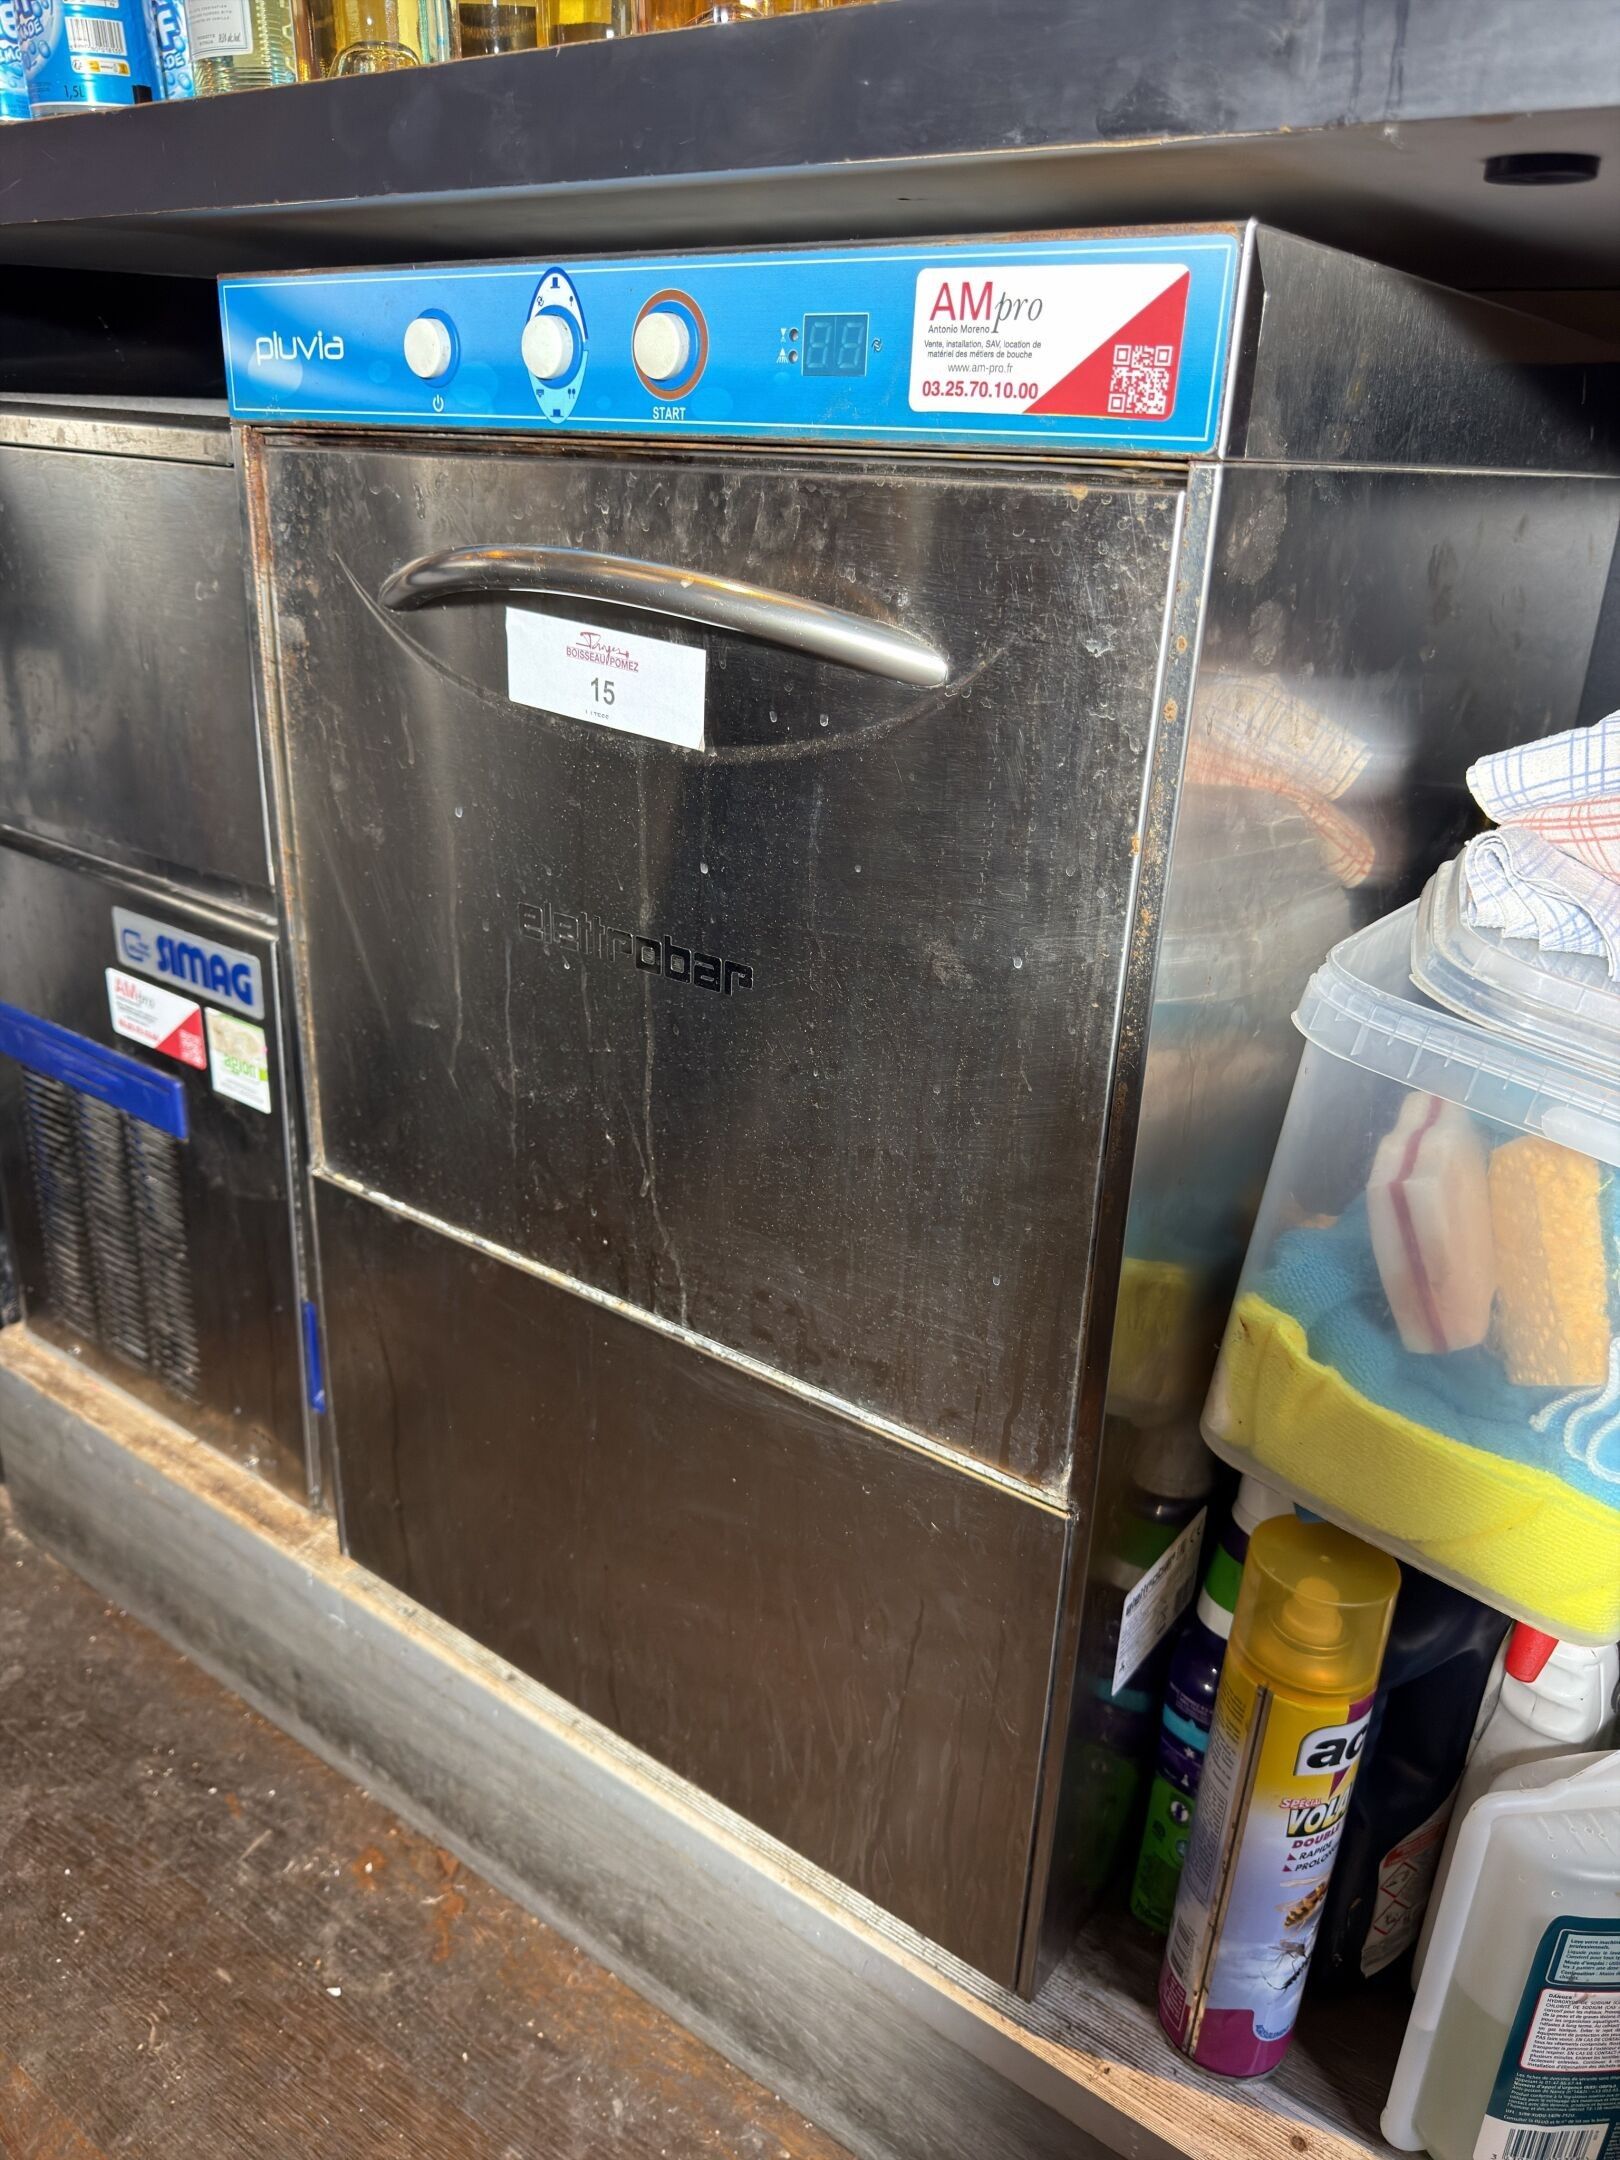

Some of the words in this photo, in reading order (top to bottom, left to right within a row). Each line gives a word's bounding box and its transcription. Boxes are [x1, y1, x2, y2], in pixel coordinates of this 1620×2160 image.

[64, 84, 86, 99] 1,5L
[928, 324, 958, 334] Antonio
[960, 324, 990, 334] Moreno
[256, 329, 344, 367] pluvia
[924, 340, 944, 349] Vente,
[946, 340, 984, 349] installation,
[986, 340, 1002, 349] SAV,
[1004, 340, 1031, 348] location
[928, 350, 954, 358] matériel
[956, 350, 968, 358] des
[969, 350, 994, 358] métiers
[1006, 351, 1032, 359] bouche
[947, 363, 1014, 376] www.am-pro.fr
[922, 380, 1039, 400] 03.25.70.10.00
[652, 406, 686, 421] START
[590, 677, 616, 706] 15
[156, 934, 254, 1006] SIMAG
